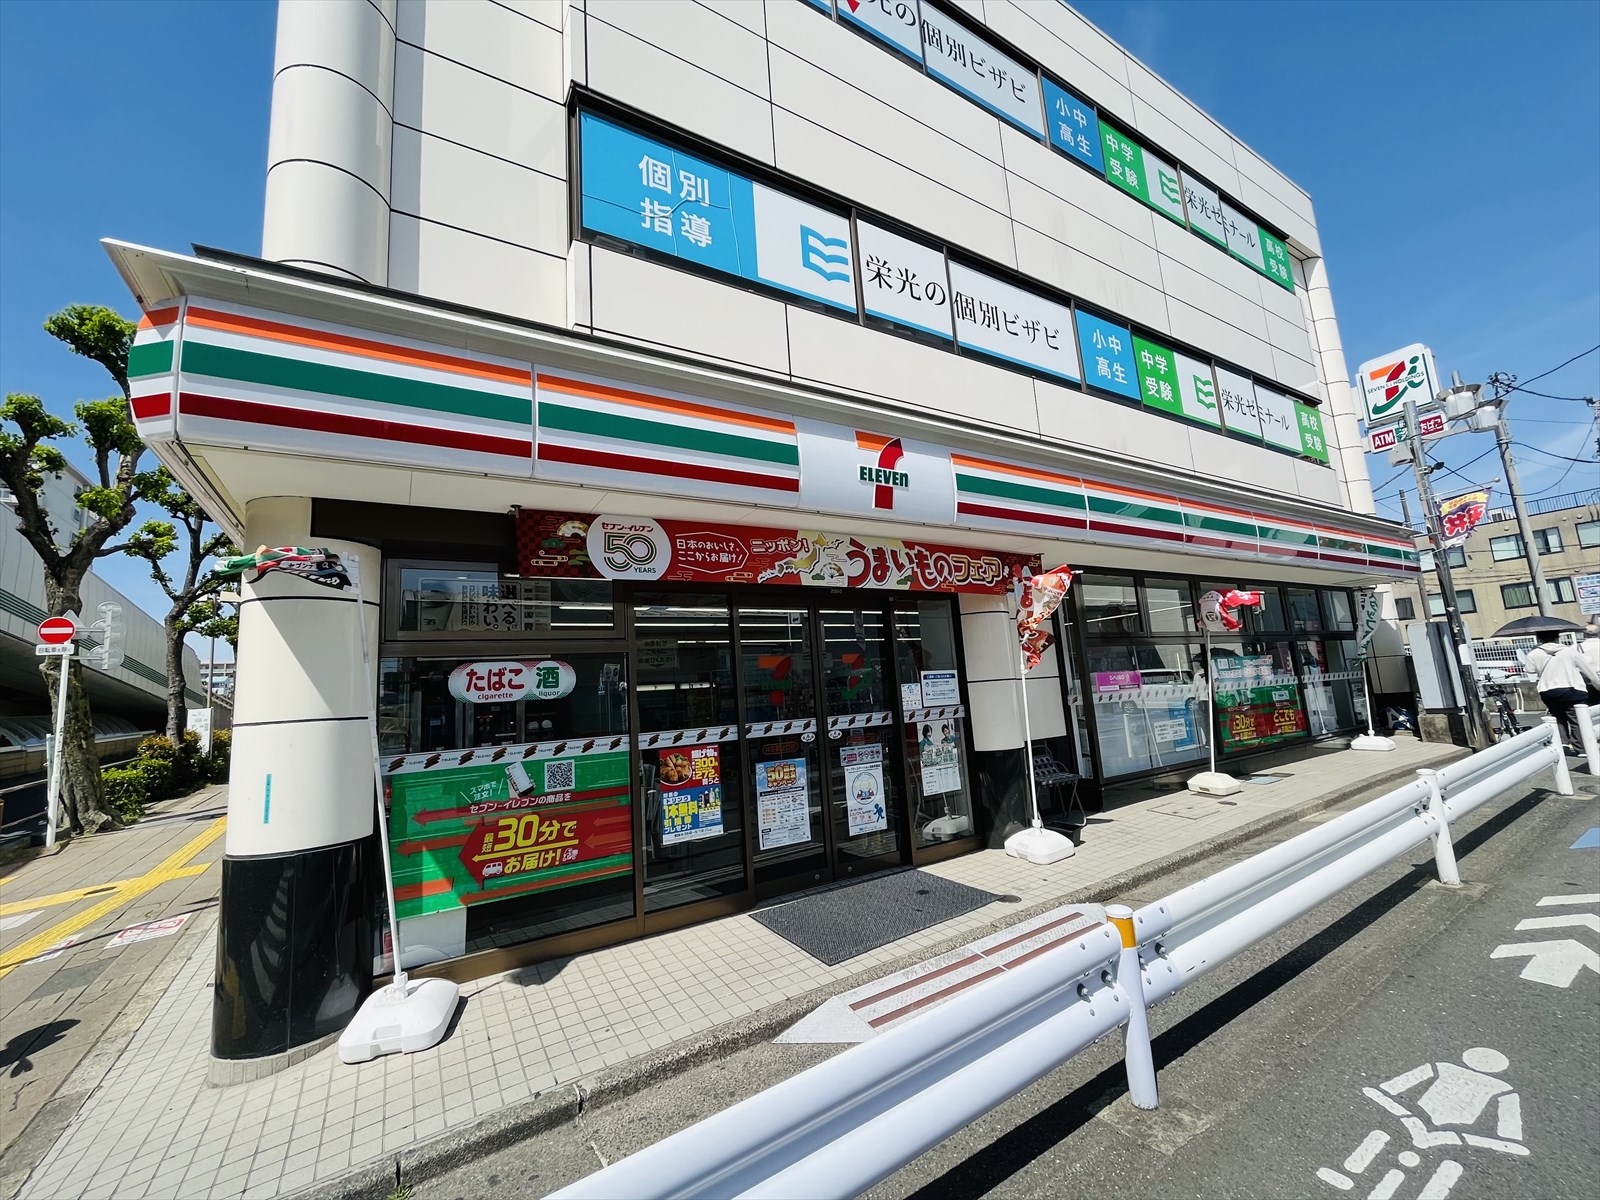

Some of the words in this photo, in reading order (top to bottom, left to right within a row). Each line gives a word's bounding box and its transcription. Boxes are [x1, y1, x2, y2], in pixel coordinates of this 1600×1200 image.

[1055, 97, 1088, 129] 小中
[1059, 120, 1092, 158] 高生
[1106, 133, 1134, 162] 中学
[638, 154, 709, 207] 個別
[1109, 158, 1141, 190] 受験
[640, 197, 712, 248] 指導
[1264, 237, 1284, 262] 高校
[1269, 255, 1290, 282] 受験
[1092, 328, 1123, 353] 小中
[1096, 355, 1128, 385] 高生
[1141, 348, 1168, 375] 中学
[1145, 375, 1174, 404] 受験
[1367, 383, 1386, 395] SEVEN
[1393, 371, 1425, 385] HOLDINGS
[1300, 411, 1319, 432] 高校
[1304, 431, 1324, 453] 受験
[1375, 432, 1395, 447] ATM
[603, 532, 657, 573] 50
[465, 667, 525, 693] たばこ
[535, 666, 560, 689] 酒
[477, 692, 514, 701] cigarette
[538, 690, 561, 698] liquor
[470, 781, 497, 795] スマホで
[504, 849, 561, 875] お届け!
